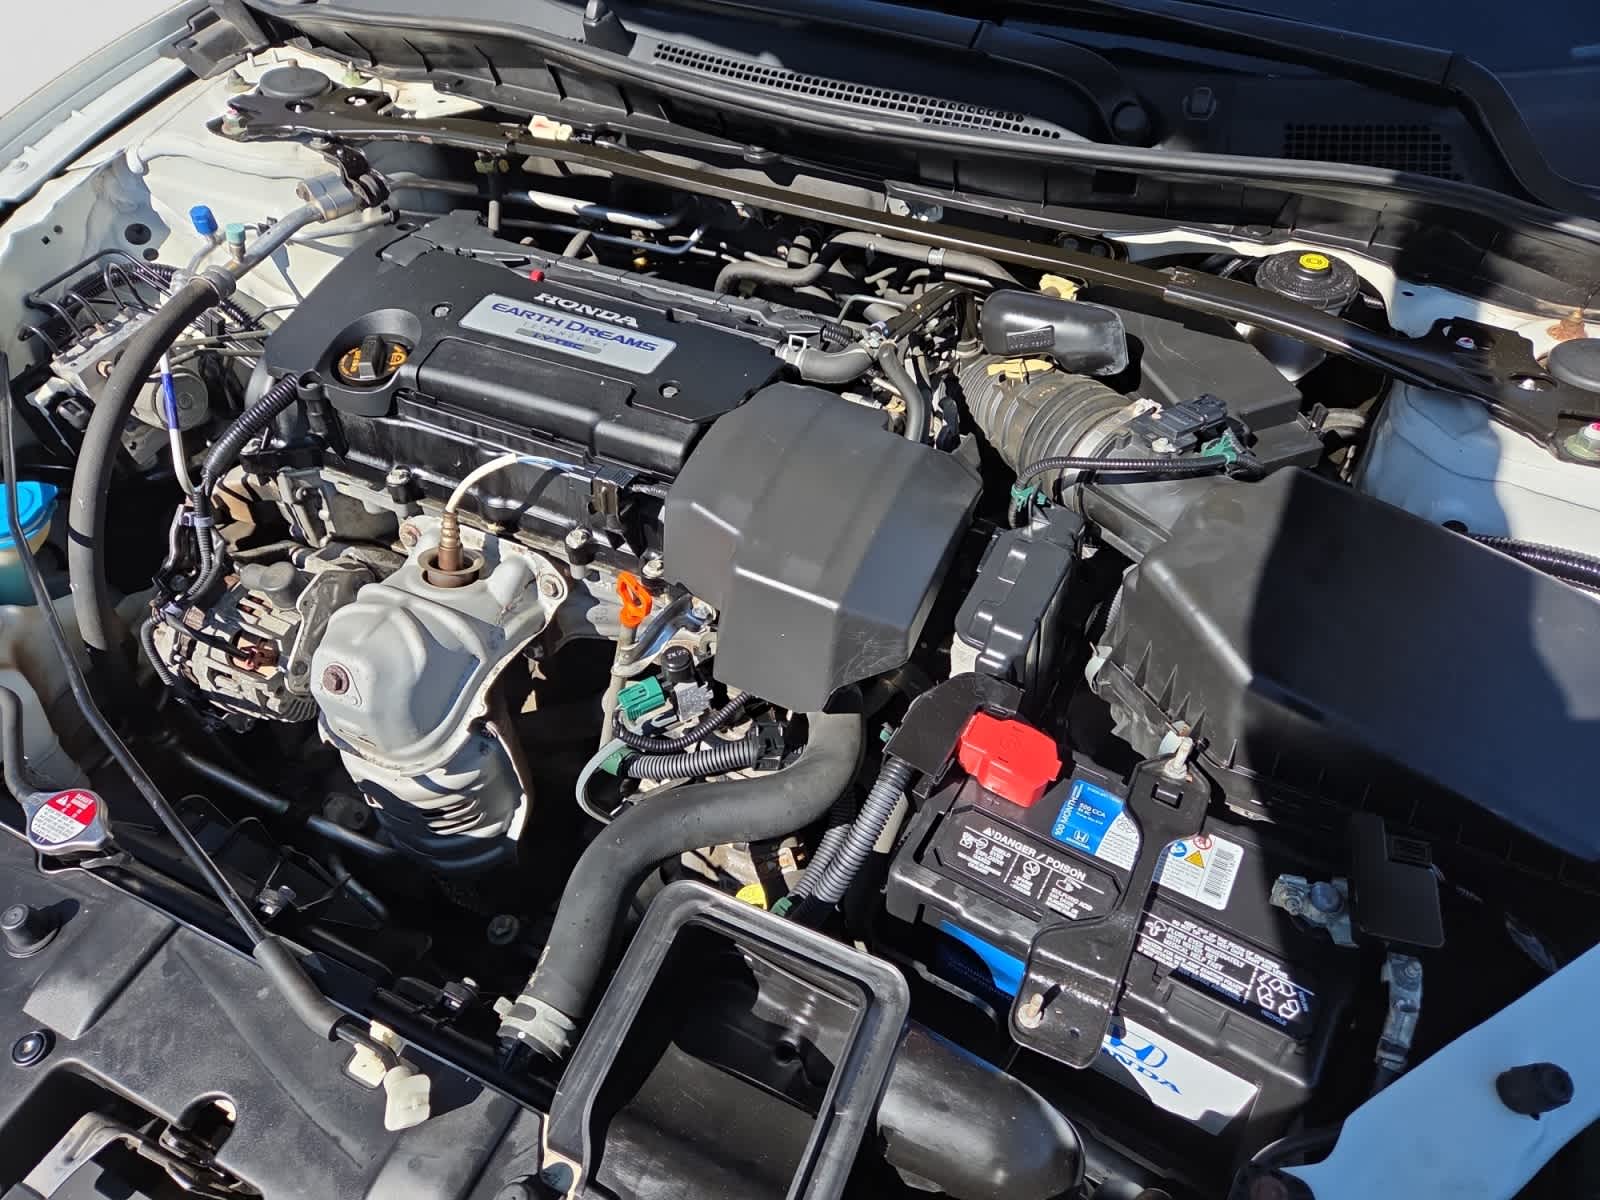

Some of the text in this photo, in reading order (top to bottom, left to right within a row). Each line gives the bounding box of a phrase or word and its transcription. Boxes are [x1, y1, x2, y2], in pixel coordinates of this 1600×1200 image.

[492, 303, 658, 352] EARTH DREAMS
[534, 292, 639, 328] HONDA
[1059, 795, 1079, 823] MONTH
[1091, 807, 1106, 819] CCA
[992, 832, 1037, 857] DANGER
[1044, 856, 1087, 881] POISON
[1100, 1046, 1183, 1096] NDA
